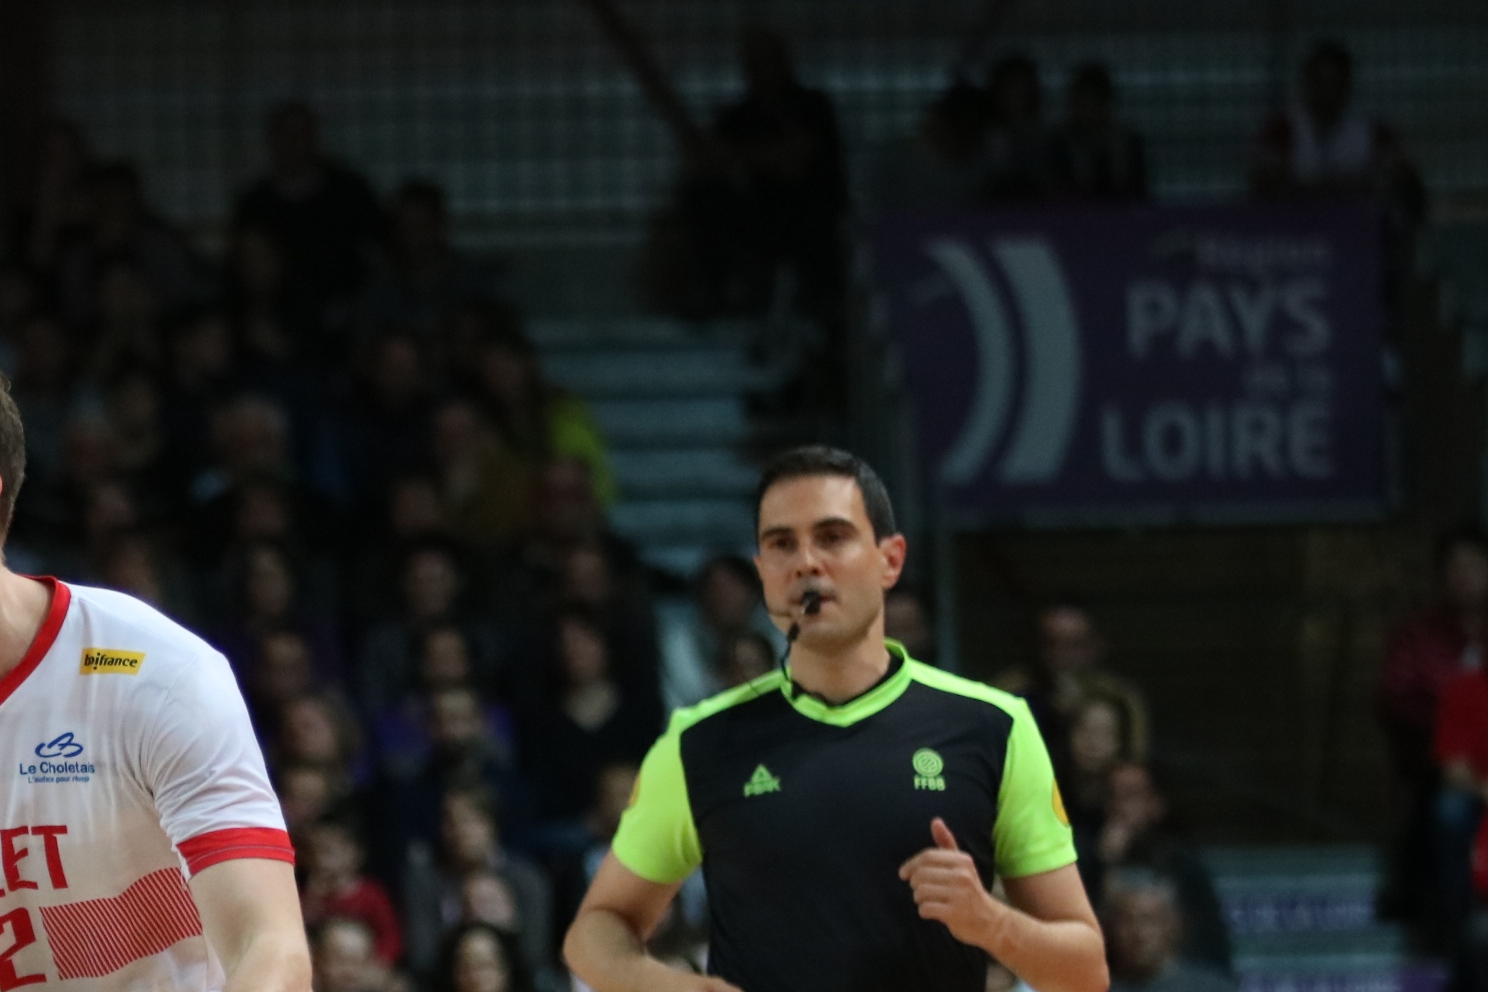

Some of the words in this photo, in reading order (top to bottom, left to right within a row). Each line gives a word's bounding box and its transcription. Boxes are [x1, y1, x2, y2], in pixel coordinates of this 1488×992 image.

[1126, 278, 1331, 358] PAYS
[1101, 402, 1334, 482] LOIRE
[19, 763, 37, 775] Le
[40, 761, 95, 774] Choletais
